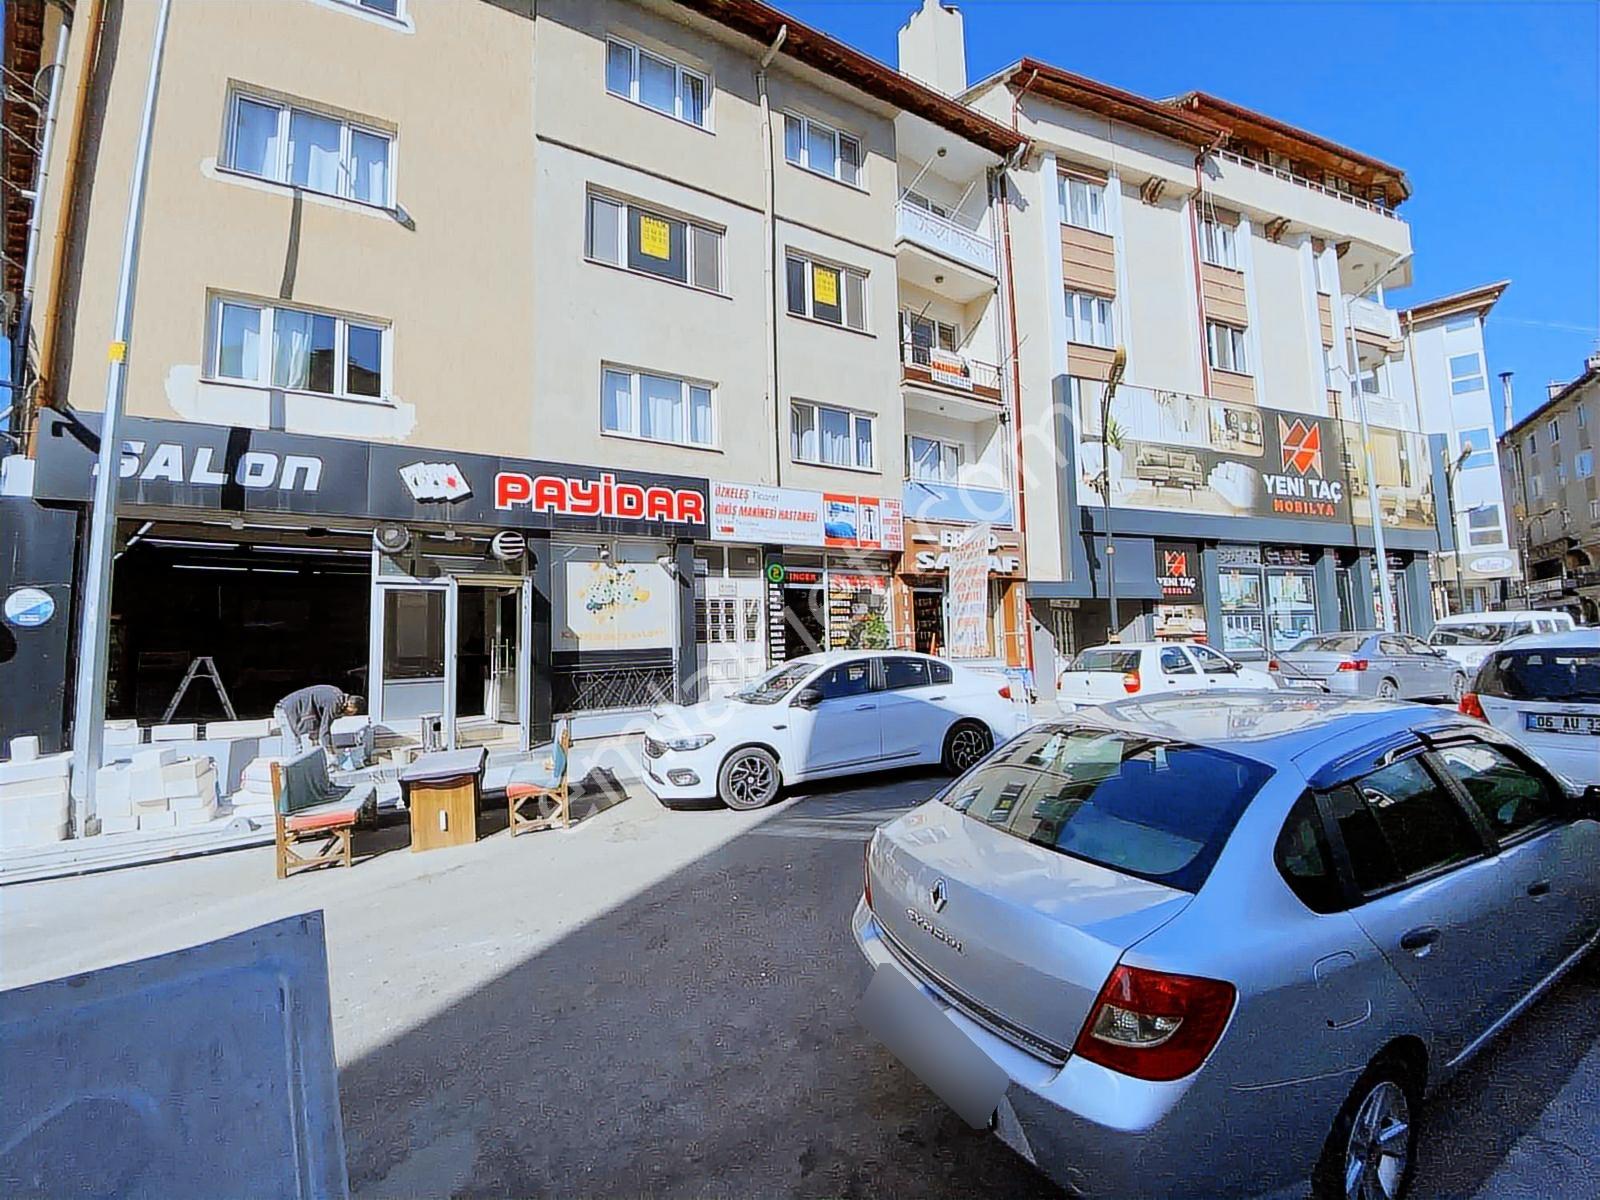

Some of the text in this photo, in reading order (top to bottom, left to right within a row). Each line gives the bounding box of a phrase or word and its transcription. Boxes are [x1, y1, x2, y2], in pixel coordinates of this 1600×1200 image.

[494, 471, 706, 525] PAYİDAR
[1308, 479, 1342, 503] TAÇ
[916, 551, 1020, 574] SAAF
[1537, 716, 1554, 728] 06
[1563, 717, 1579, 730] AU
